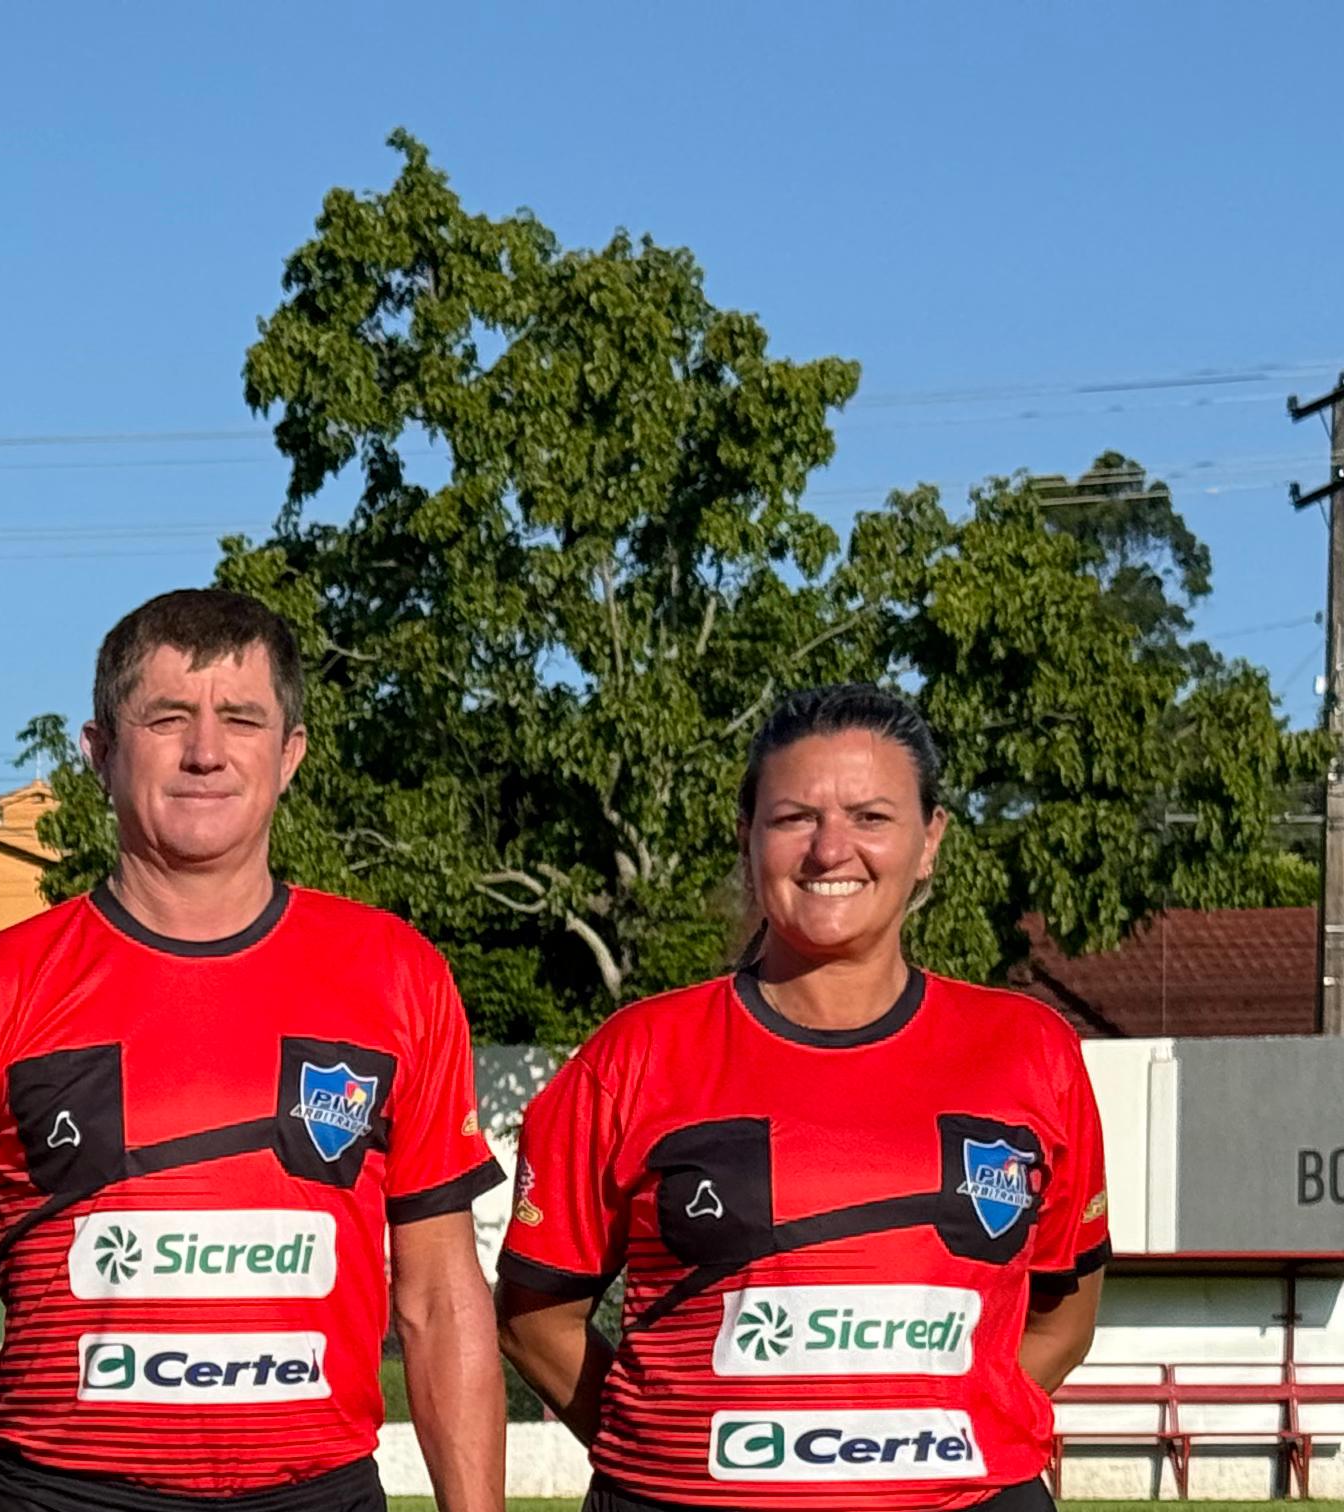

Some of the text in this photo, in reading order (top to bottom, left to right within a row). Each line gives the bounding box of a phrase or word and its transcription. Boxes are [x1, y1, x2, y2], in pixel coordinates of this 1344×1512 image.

[153, 1233, 316, 1275] Sicredi
[805, 1308, 966, 1352] Sicredi
[143, 1349, 320, 1388] Certel
[793, 1428, 973, 1464] Certel
